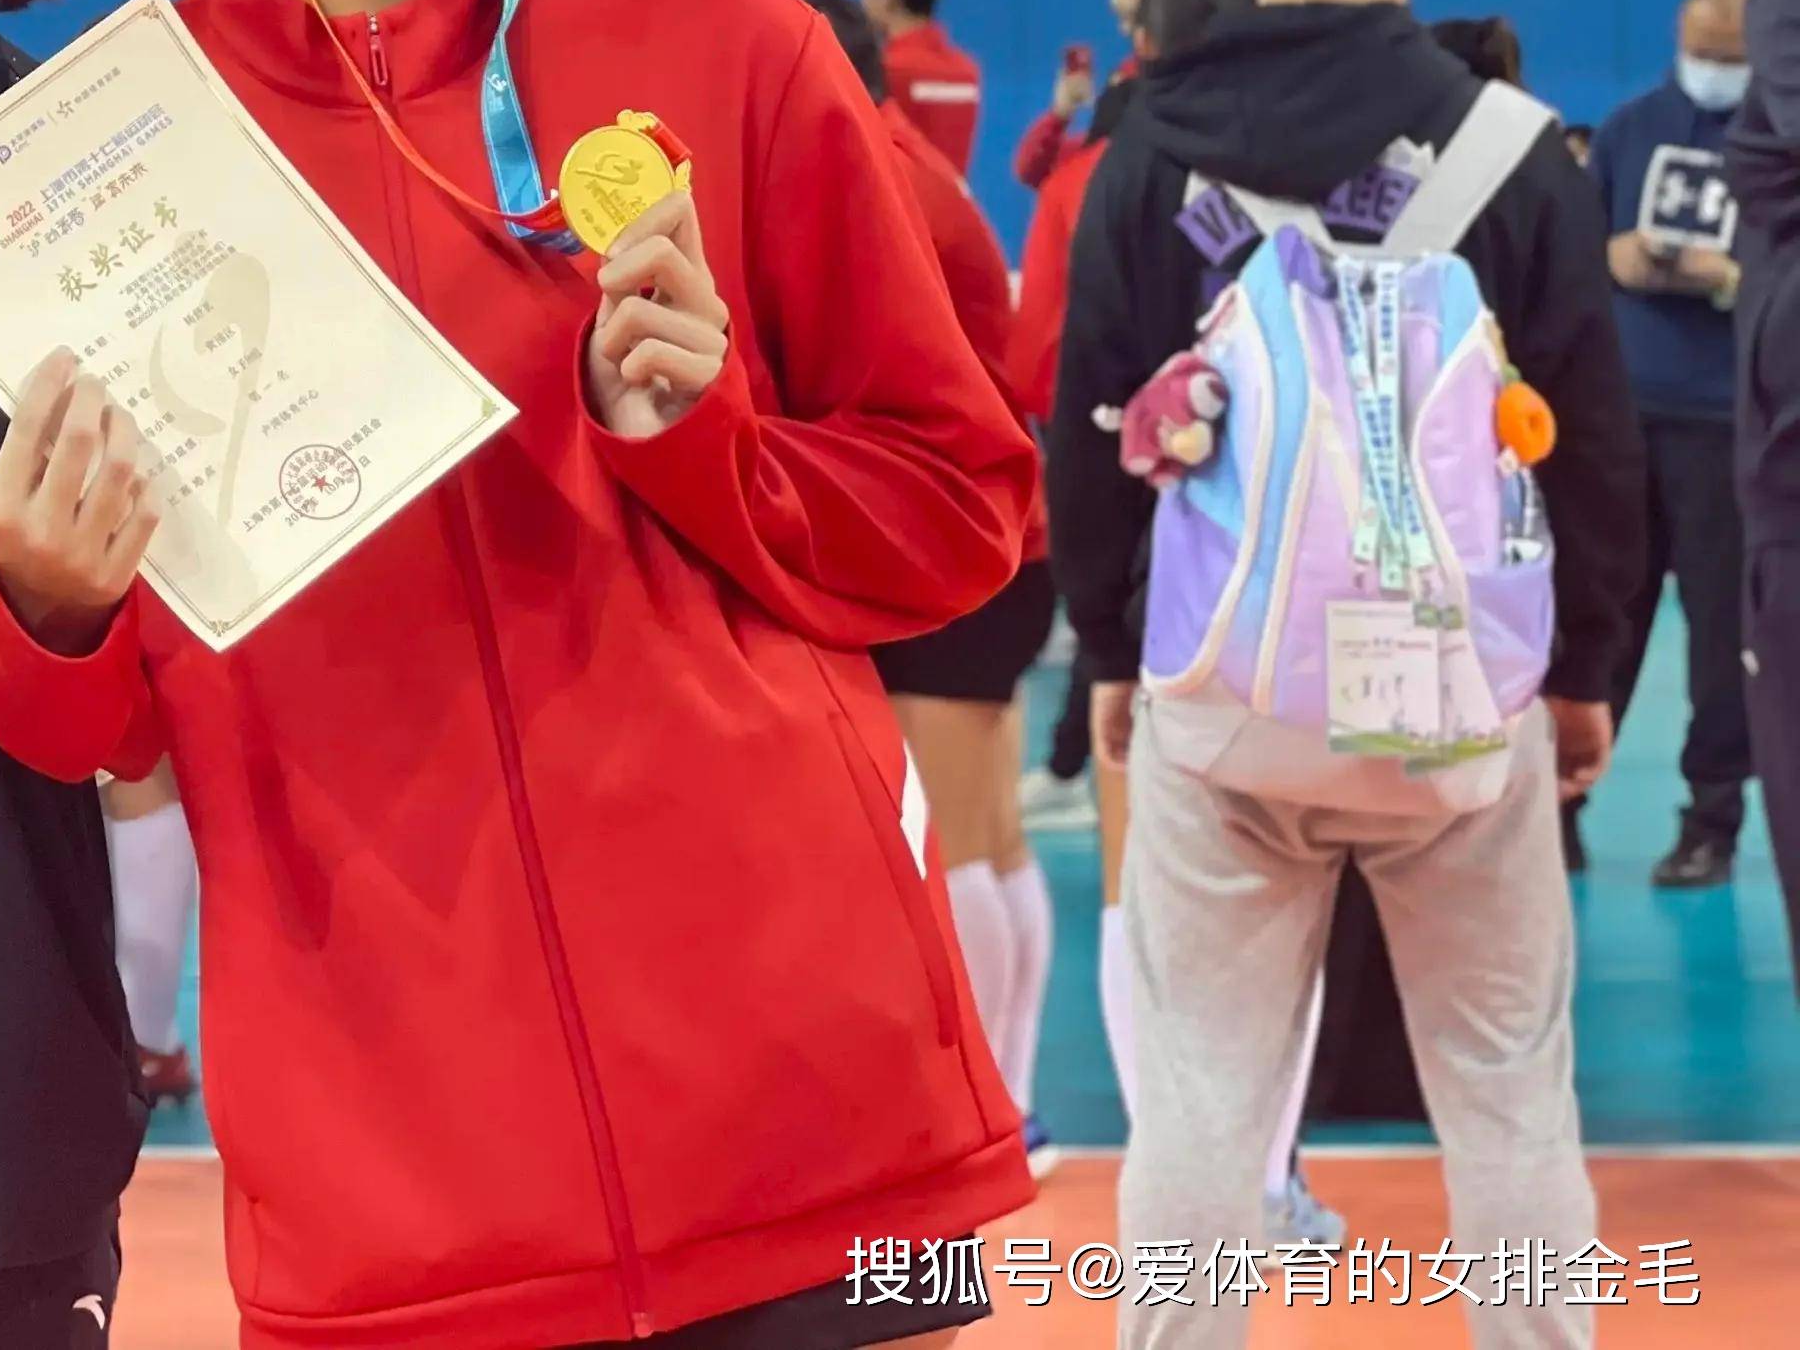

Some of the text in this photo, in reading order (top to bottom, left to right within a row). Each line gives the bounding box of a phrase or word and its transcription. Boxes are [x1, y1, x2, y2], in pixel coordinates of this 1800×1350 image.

[5, 199, 36, 227] 2022
[45, 113, 174, 214] 17TH SHANGHAI GAMES
[54, 194, 178, 301] 获奖证书
